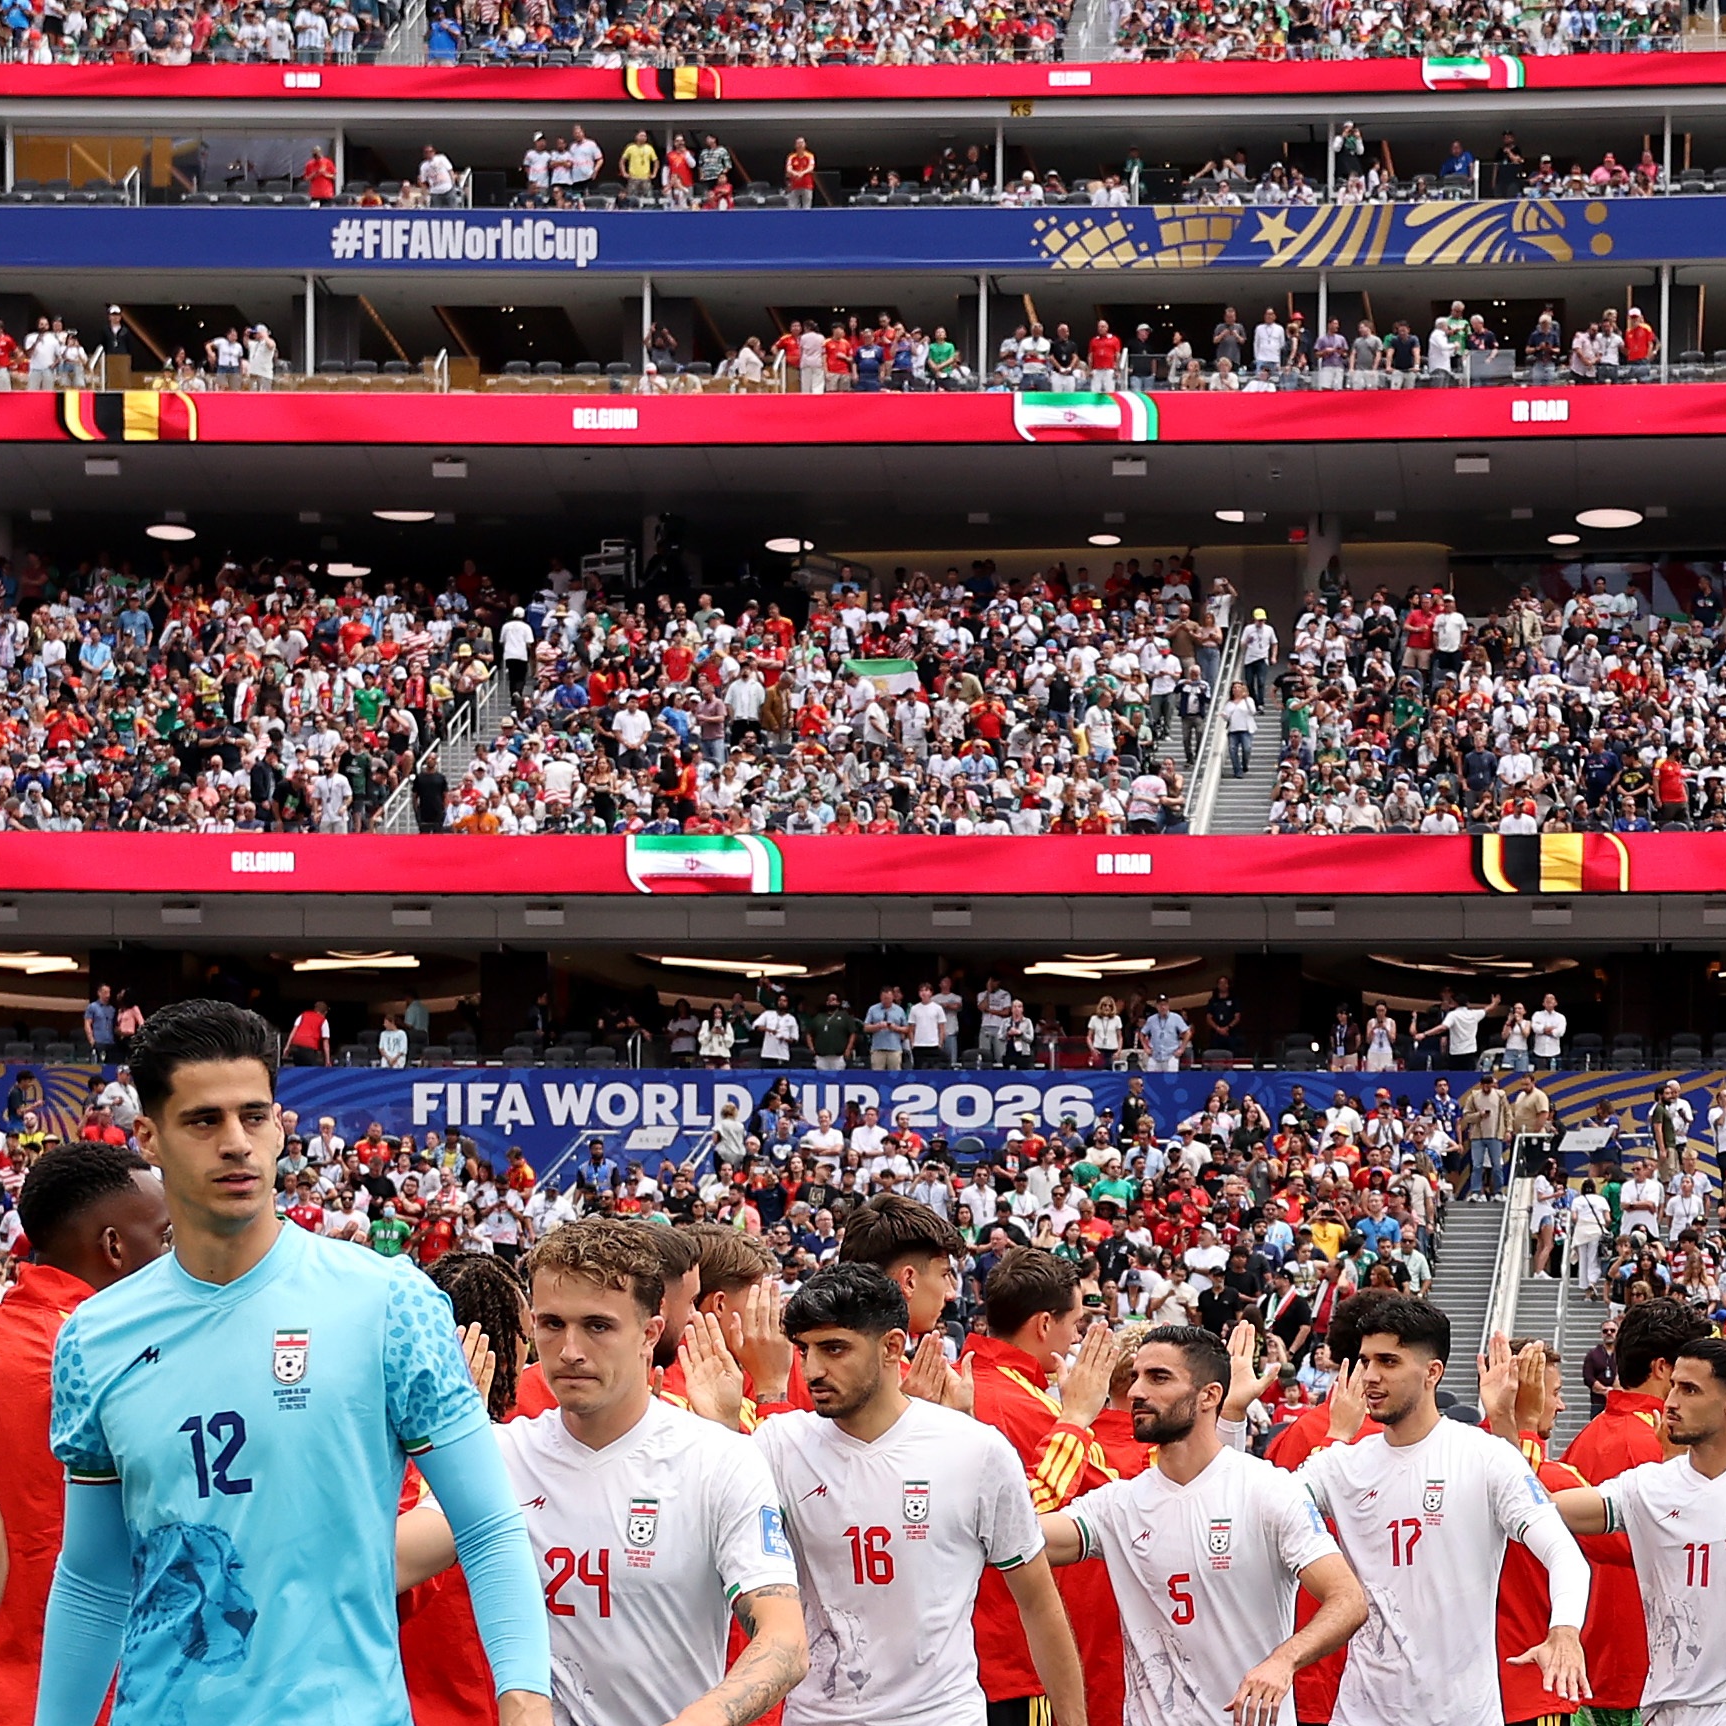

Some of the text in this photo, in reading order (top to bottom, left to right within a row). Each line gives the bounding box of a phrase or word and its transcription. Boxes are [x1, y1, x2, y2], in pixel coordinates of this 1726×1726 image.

[331, 216, 600, 267] #FIFAWorldCup
[573, 408, 638, 430] BELGIUM
[1512, 400, 1569, 422] IR IRAN
[231, 852, 295, 872] BELGIUM
[1096, 854, 1152, 874] IR IRAN
[412, 1083, 1094, 1128] FIFA WORLD UP 2026
[178, 1410, 253, 1499] 12
[842, 1526, 895, 1585] 16
[1386, 1518, 1423, 1567] 17
[1682, 1543, 1711, 1588] 11
[544, 1546, 611, 1618] 24
[1167, 1573, 1195, 1626] 5
